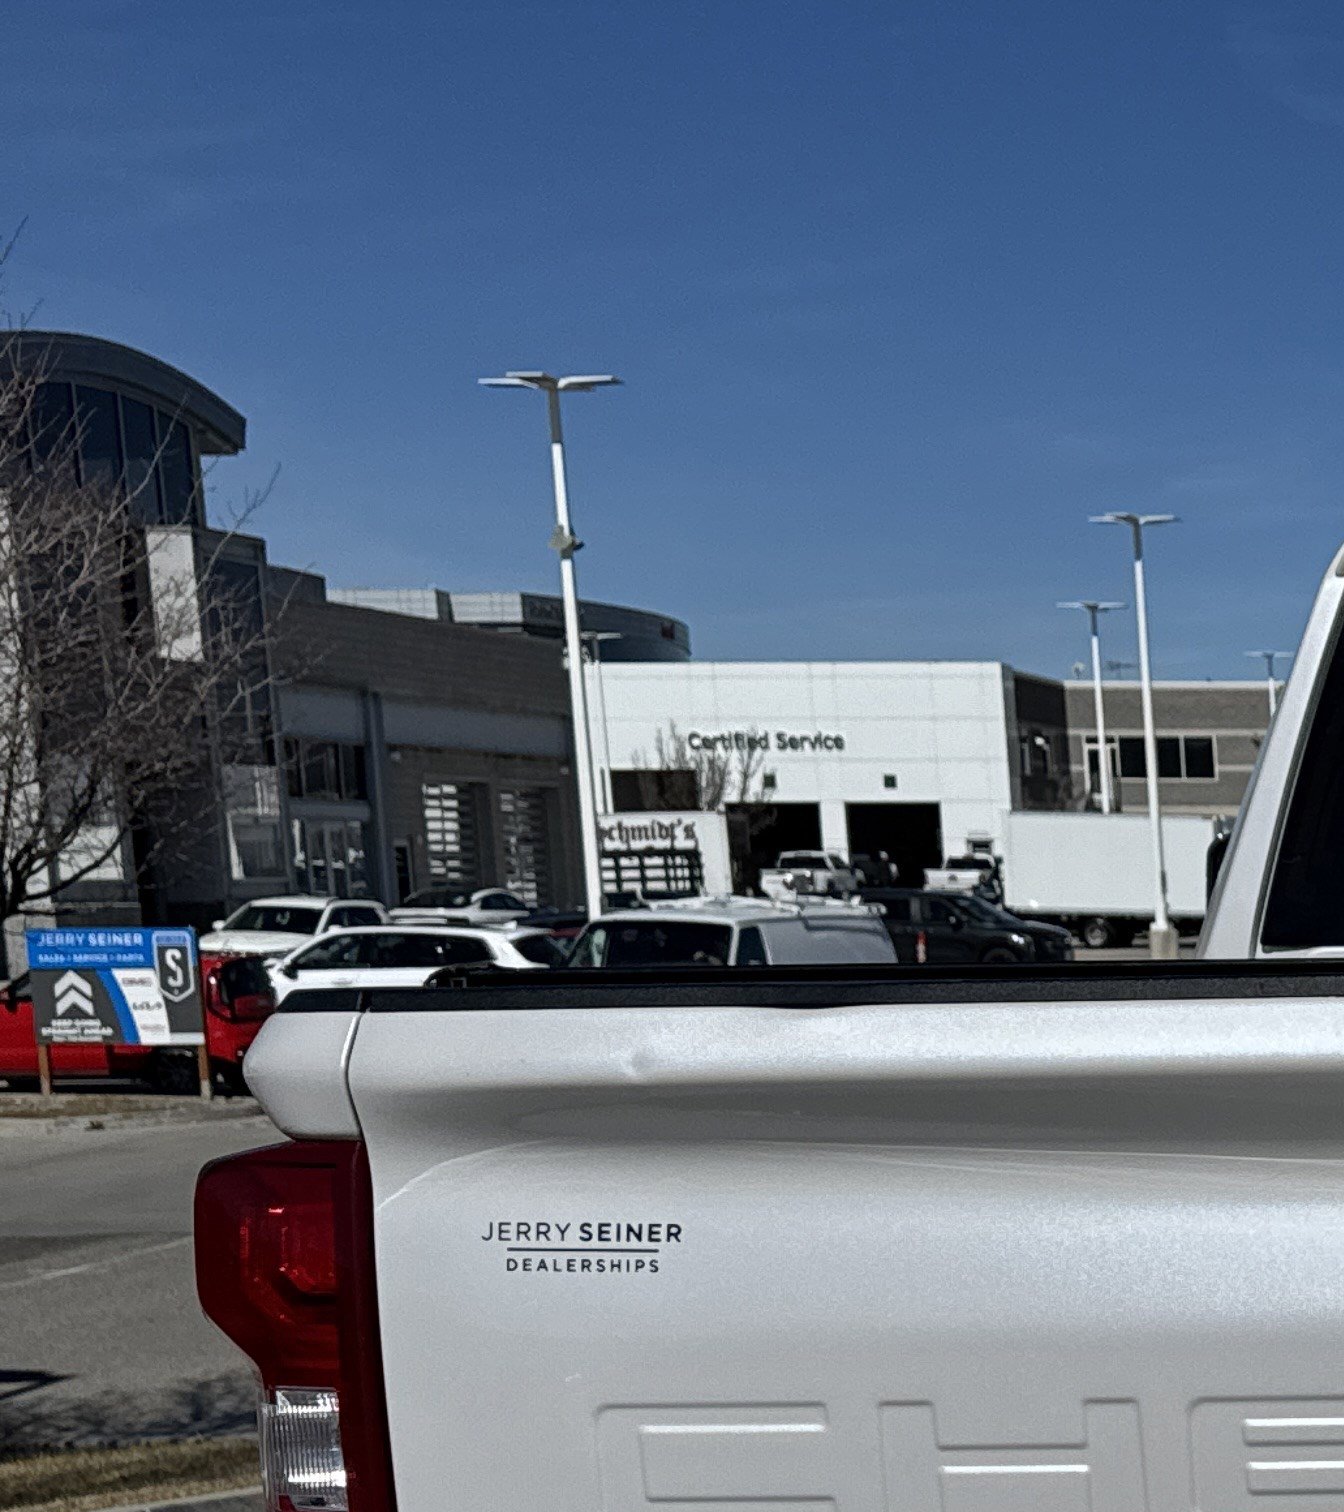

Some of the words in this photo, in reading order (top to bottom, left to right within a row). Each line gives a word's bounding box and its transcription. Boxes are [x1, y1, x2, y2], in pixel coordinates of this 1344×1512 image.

[688, 731, 769, 750] Certified
[776, 731, 845, 750] Service
[37, 932, 85, 946] JERRY
[88, 932, 144, 946] SEINER
[481, 1221, 571, 1242] JERRY
[578, 1222, 682, 1243] SEINER
[506, 1258, 660, 1273] DEALERSHIPS
